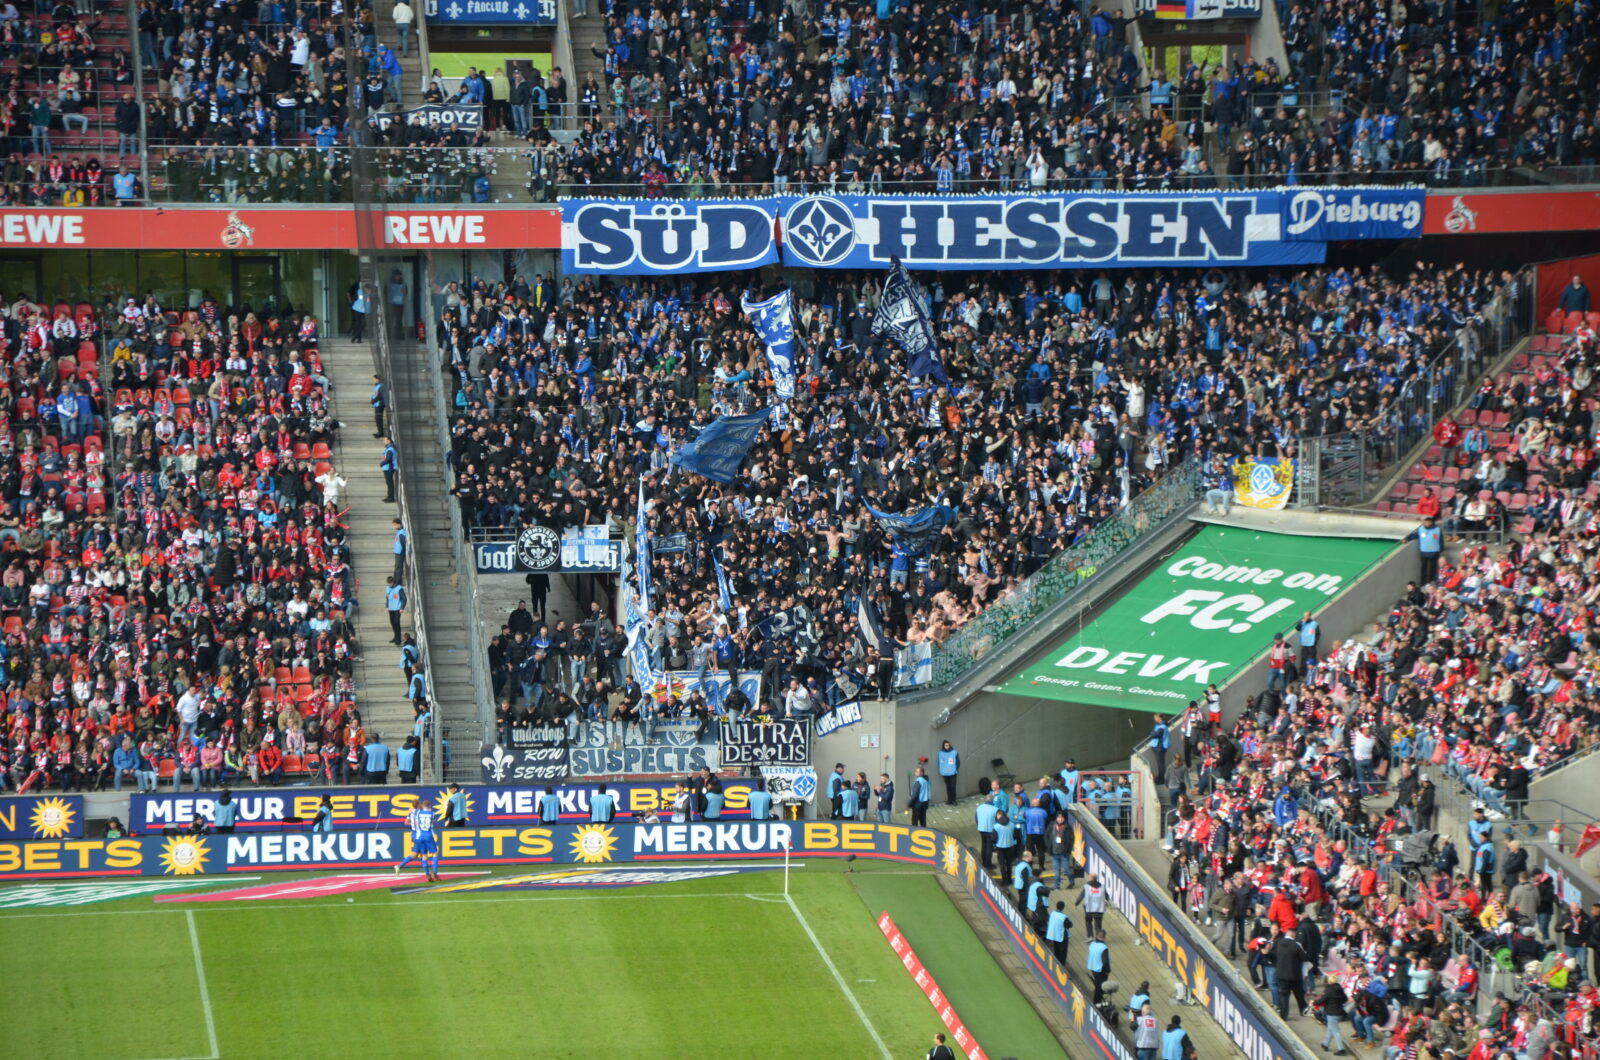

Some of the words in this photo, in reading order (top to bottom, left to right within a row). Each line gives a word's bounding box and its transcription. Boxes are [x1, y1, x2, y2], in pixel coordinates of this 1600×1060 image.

[428, 110, 479, 125] BOYZ
[1286, 190, 1422, 235] Dieburg
[0, 214, 85, 243] EWE
[385, 215, 486, 244] REWE
[574, 203, 772, 271] SÜD
[868, 196, 1257, 264] HESSEN
[1167, 556, 1284, 586] Come
[1281, 571, 1343, 596] on,
[1140, 589, 1296, 634] FC!
[1054, 646, 1231, 685] DEVK
[1128, 686, 1188, 700] Geholfen.
[511, 721, 566, 746] underdogs
[722, 722, 806, 745] ULTRA
[524, 748, 565, 763] ROW
[571, 746, 709, 776] SUSPECTS
[723, 744, 752, 763] DE
[777, 744, 806, 762] LIS
[513, 764, 568, 780] SEVEN
[146, 797, 284, 823] MERUR
[294, 793, 420, 819] BETS
[227, 832, 392, 864] MERKUR
[633, 823, 793, 853] MERKUR
[804, 822, 937, 857] BETS
[0, 840, 143, 871] BETS
